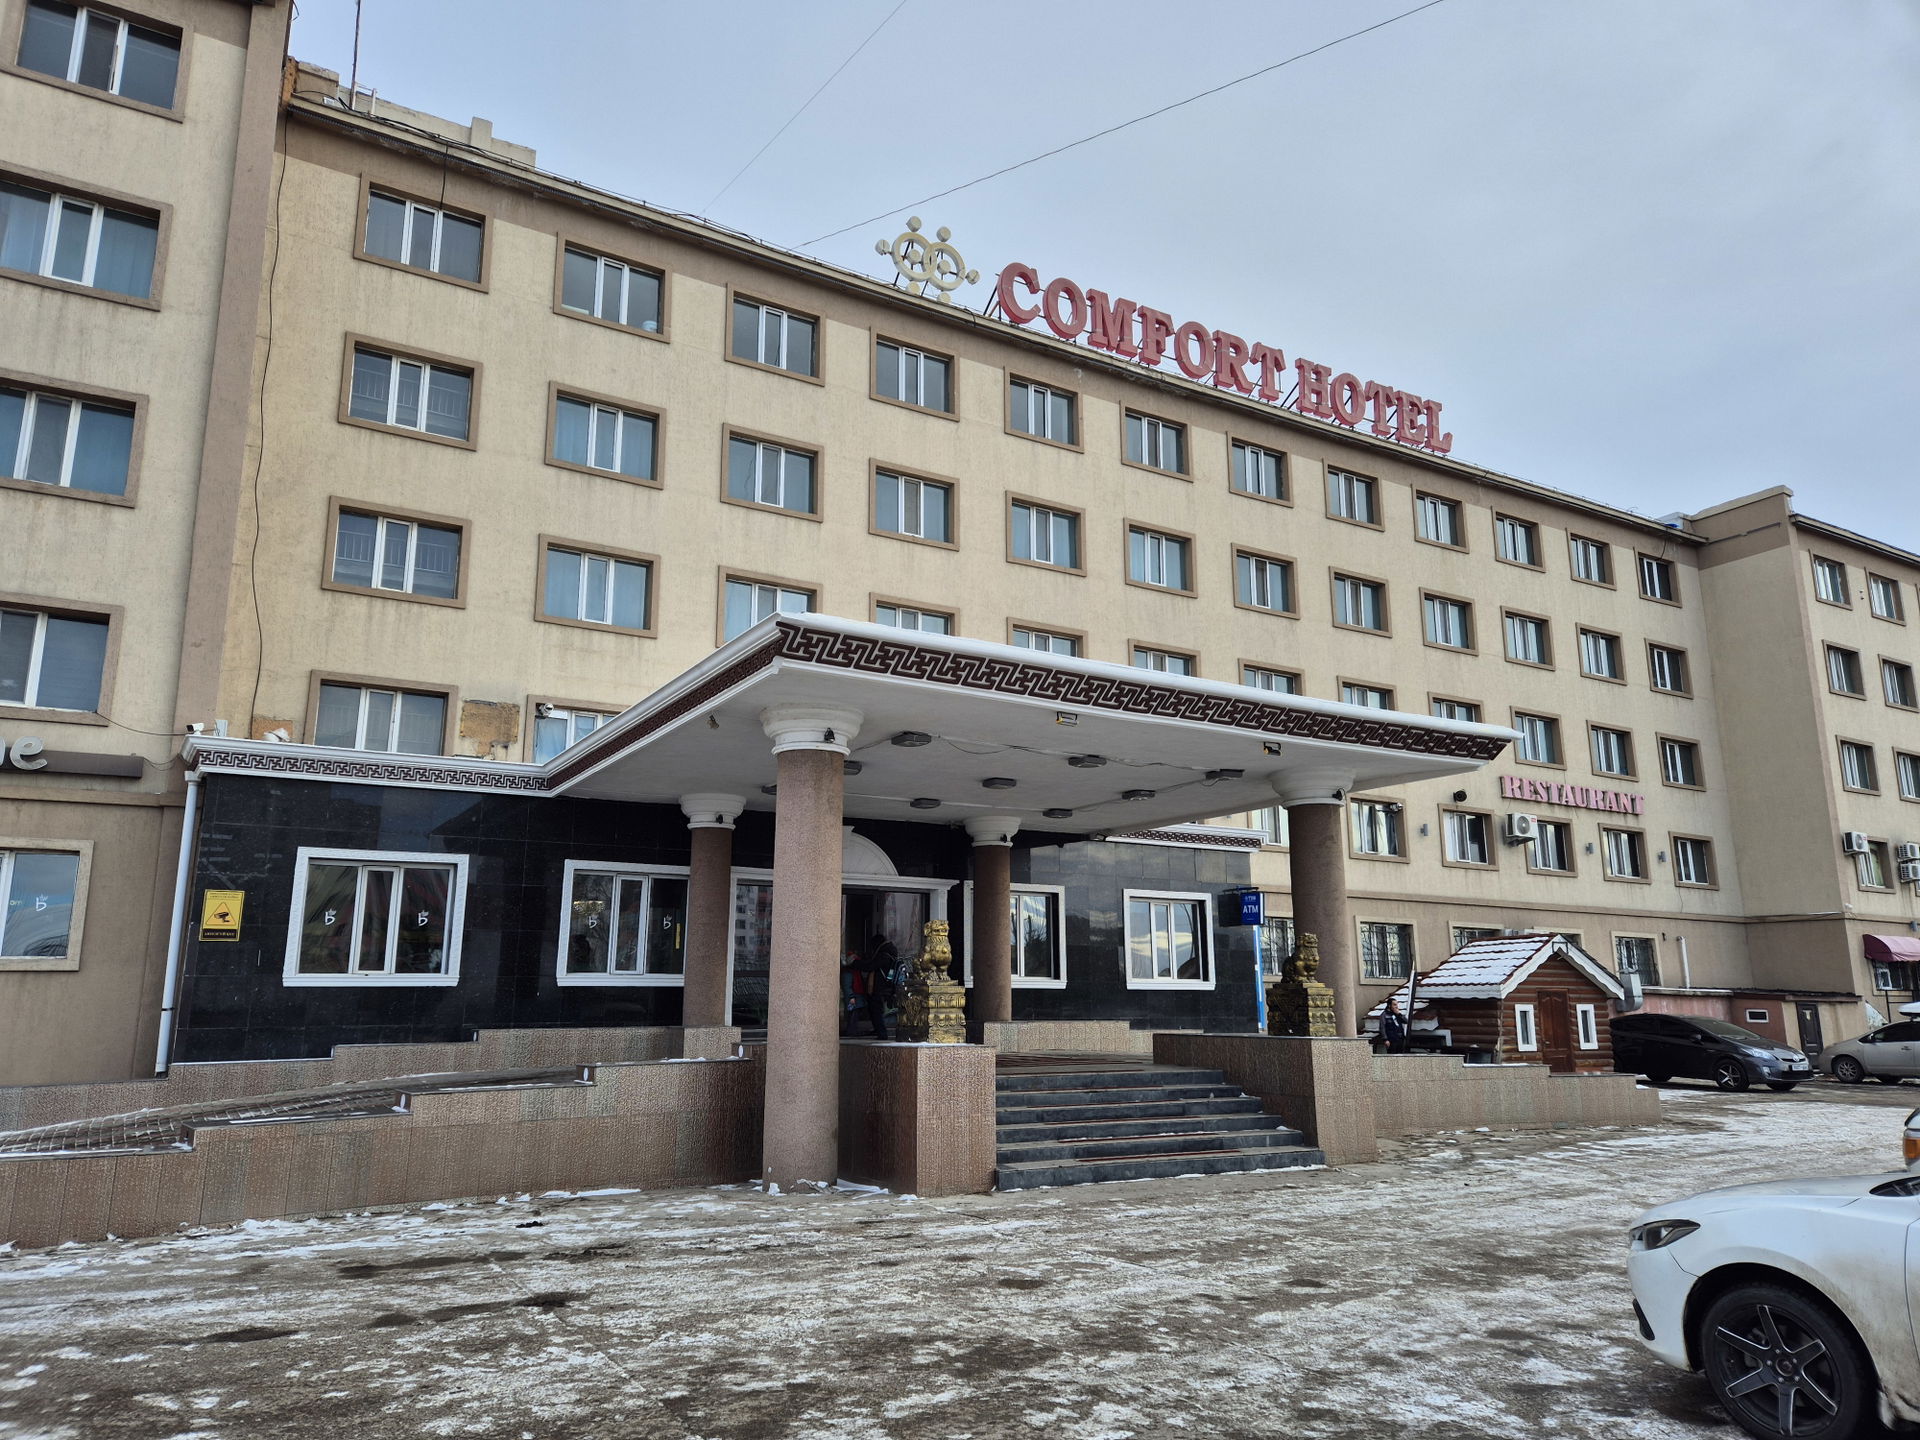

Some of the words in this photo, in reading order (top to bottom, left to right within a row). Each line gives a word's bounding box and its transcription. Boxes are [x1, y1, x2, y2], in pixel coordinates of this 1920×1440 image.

[997, 261, 1286, 402] COMFORT
[1294, 357, 1453, 454] HOTEL
[1500, 775, 1645, 815] RESTAURANT
[1242, 904, 1259, 914] ATM
